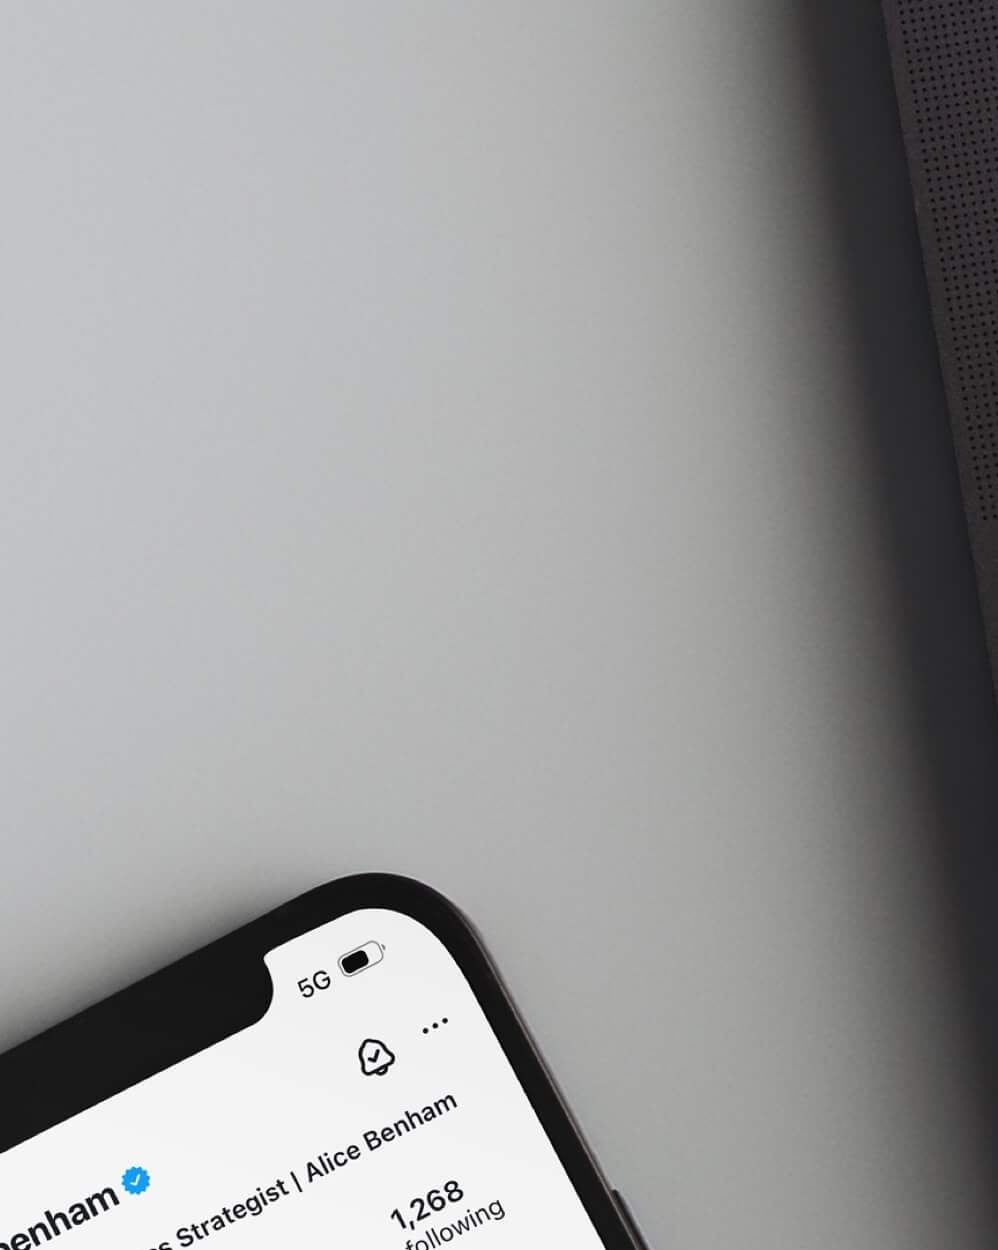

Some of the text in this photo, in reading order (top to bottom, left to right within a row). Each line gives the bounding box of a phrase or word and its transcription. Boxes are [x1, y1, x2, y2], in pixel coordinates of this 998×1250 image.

[298, 971, 330, 997] 5G
[177, 1180, 289, 1247] Strategist
[307, 1145, 360, 1182] Alice
[363, 1095, 457, 1151] Benham
[391, 1181, 463, 1228] 1,268
